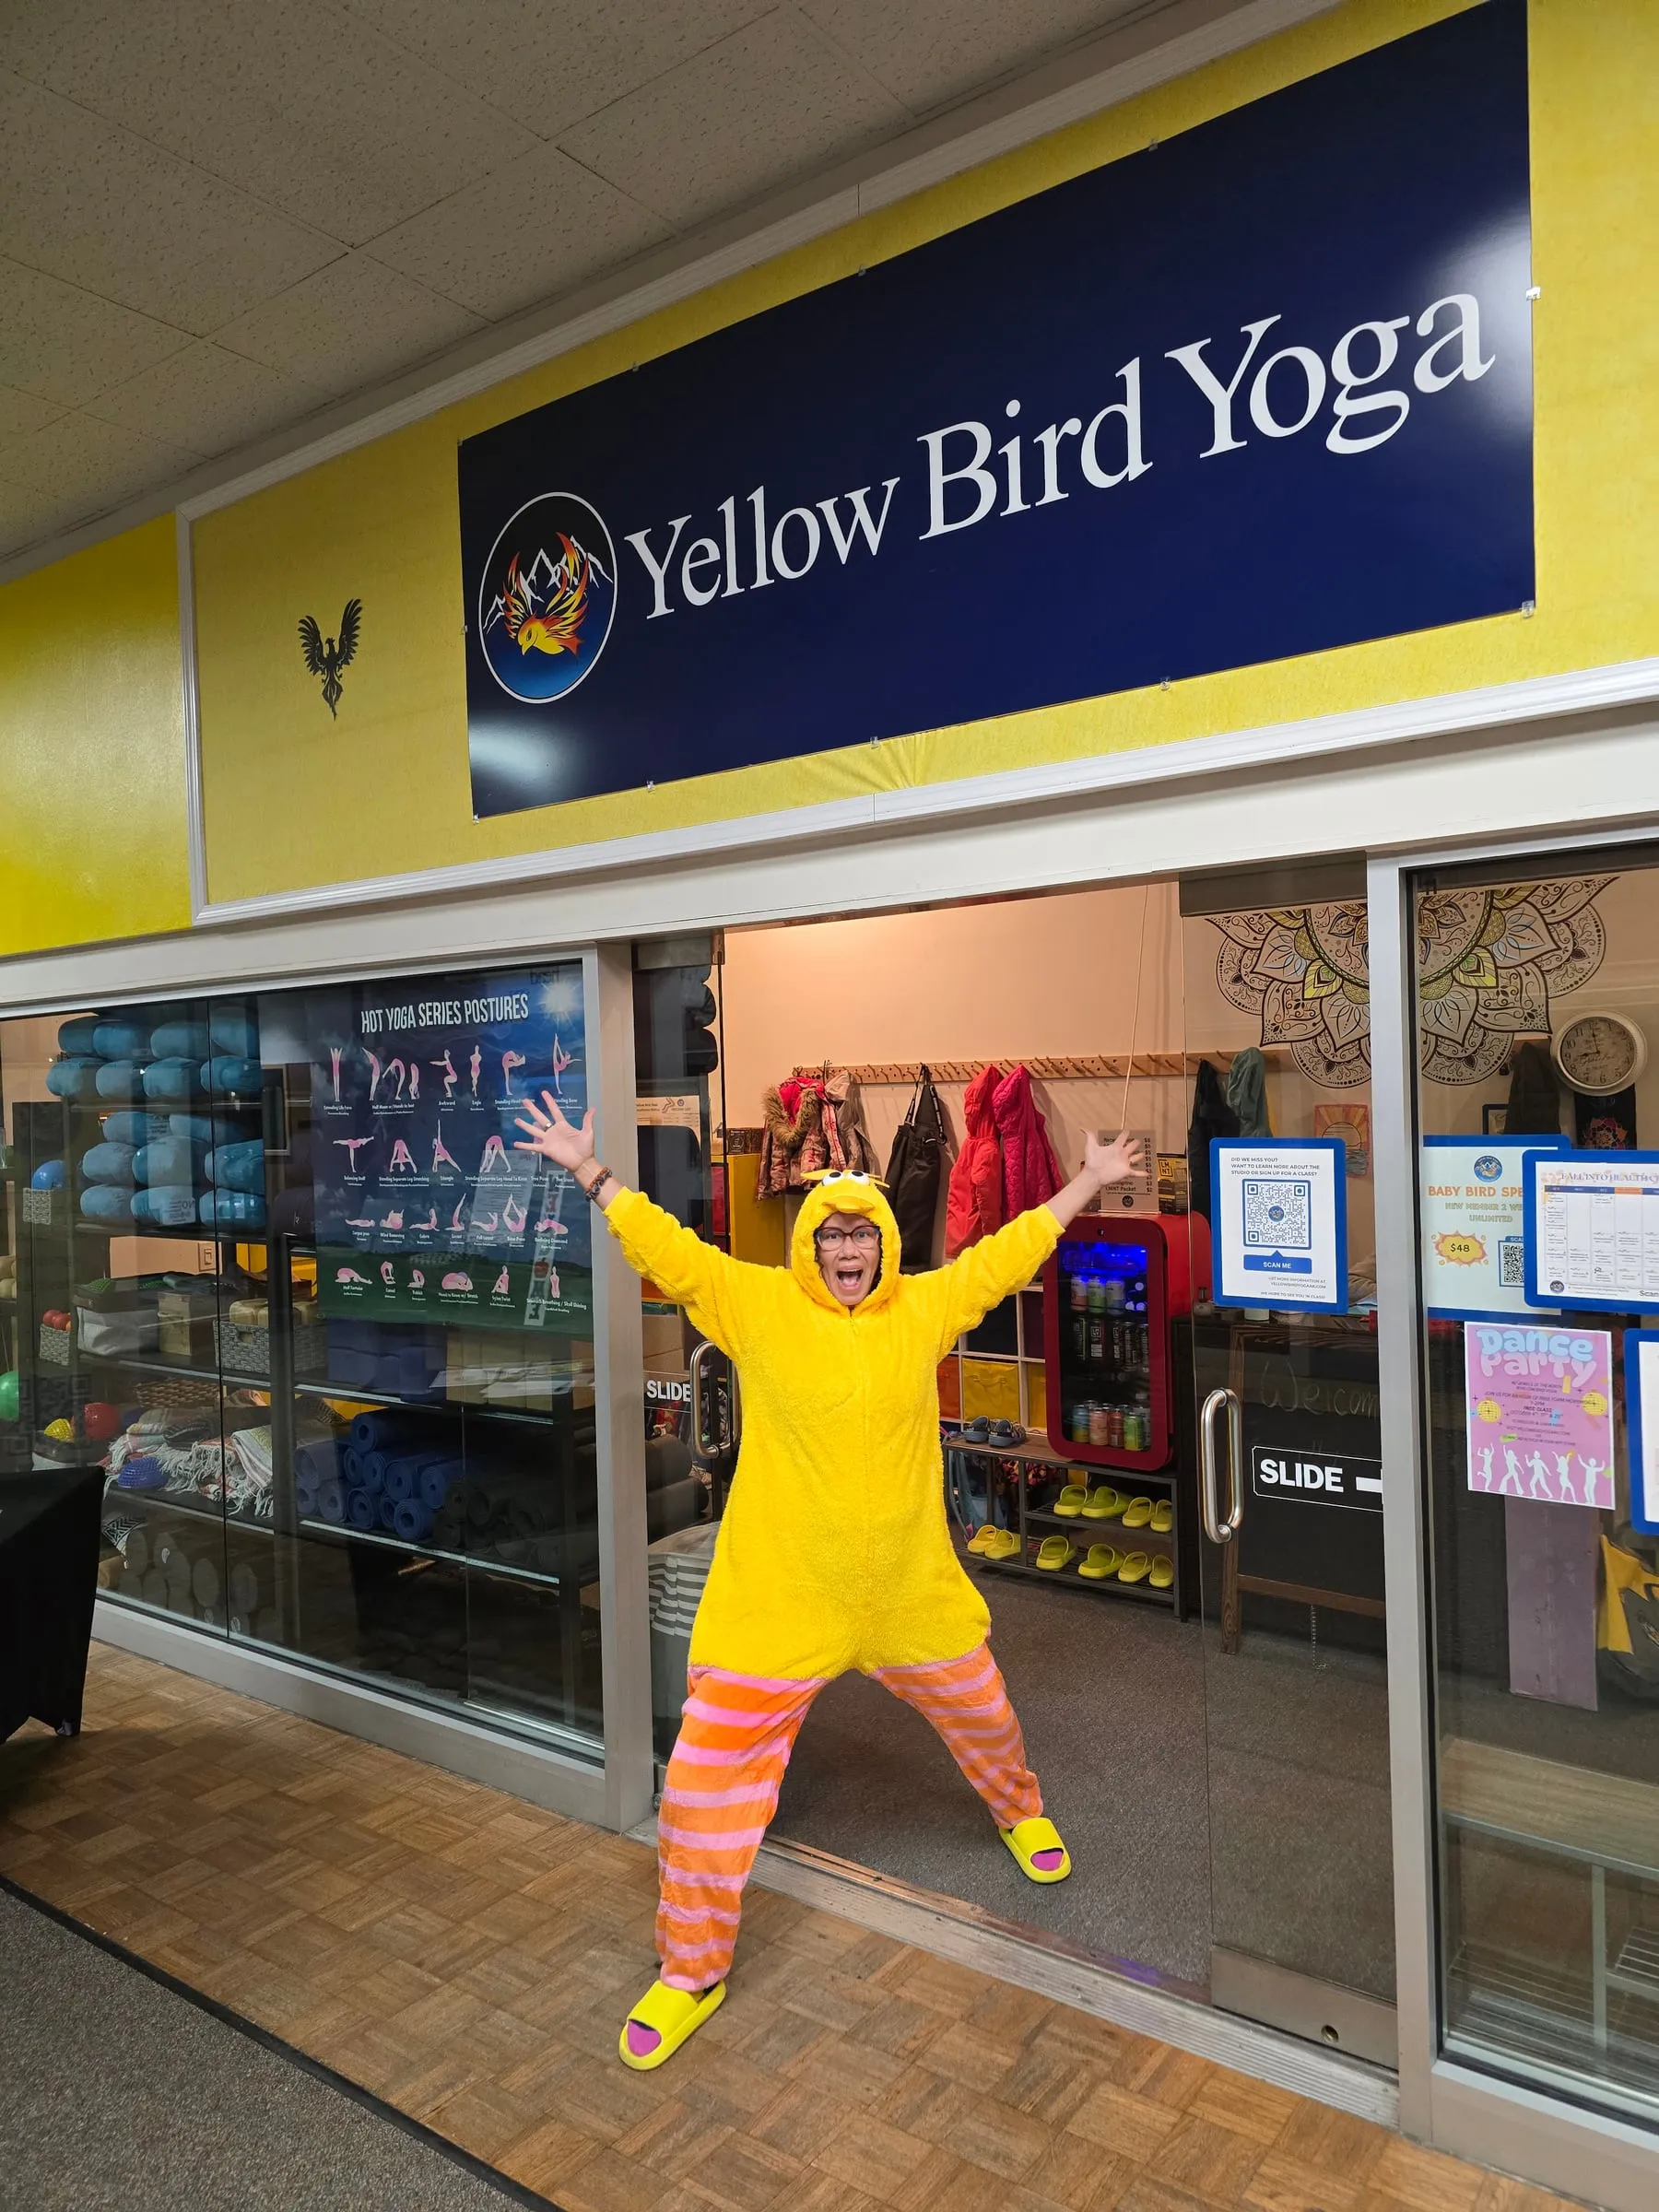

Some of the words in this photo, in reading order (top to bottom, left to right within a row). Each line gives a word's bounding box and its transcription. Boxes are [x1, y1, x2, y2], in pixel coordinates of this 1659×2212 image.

[624, 477, 900, 620] Yellow
[918, 358, 1152, 541] Bird
[1165, 291, 1495, 458] Yoga
[361, 1009, 382, 1033] HOT
[385, 1006, 416, 1030] YOGA
[418, 1001, 462, 1027] SERIES
[464, 994, 529, 1023] POSTURES
[1429, 1186, 1460, 1196] BABY
[1465, 1187, 1496, 1196] BIRD
[1451, 1242, 1470, 1253] $48
[1477, 1329, 1594, 1361] Dance
[647, 1380, 691, 1401] SLIDE
[1259, 1458, 1344, 1493] SLIDE
